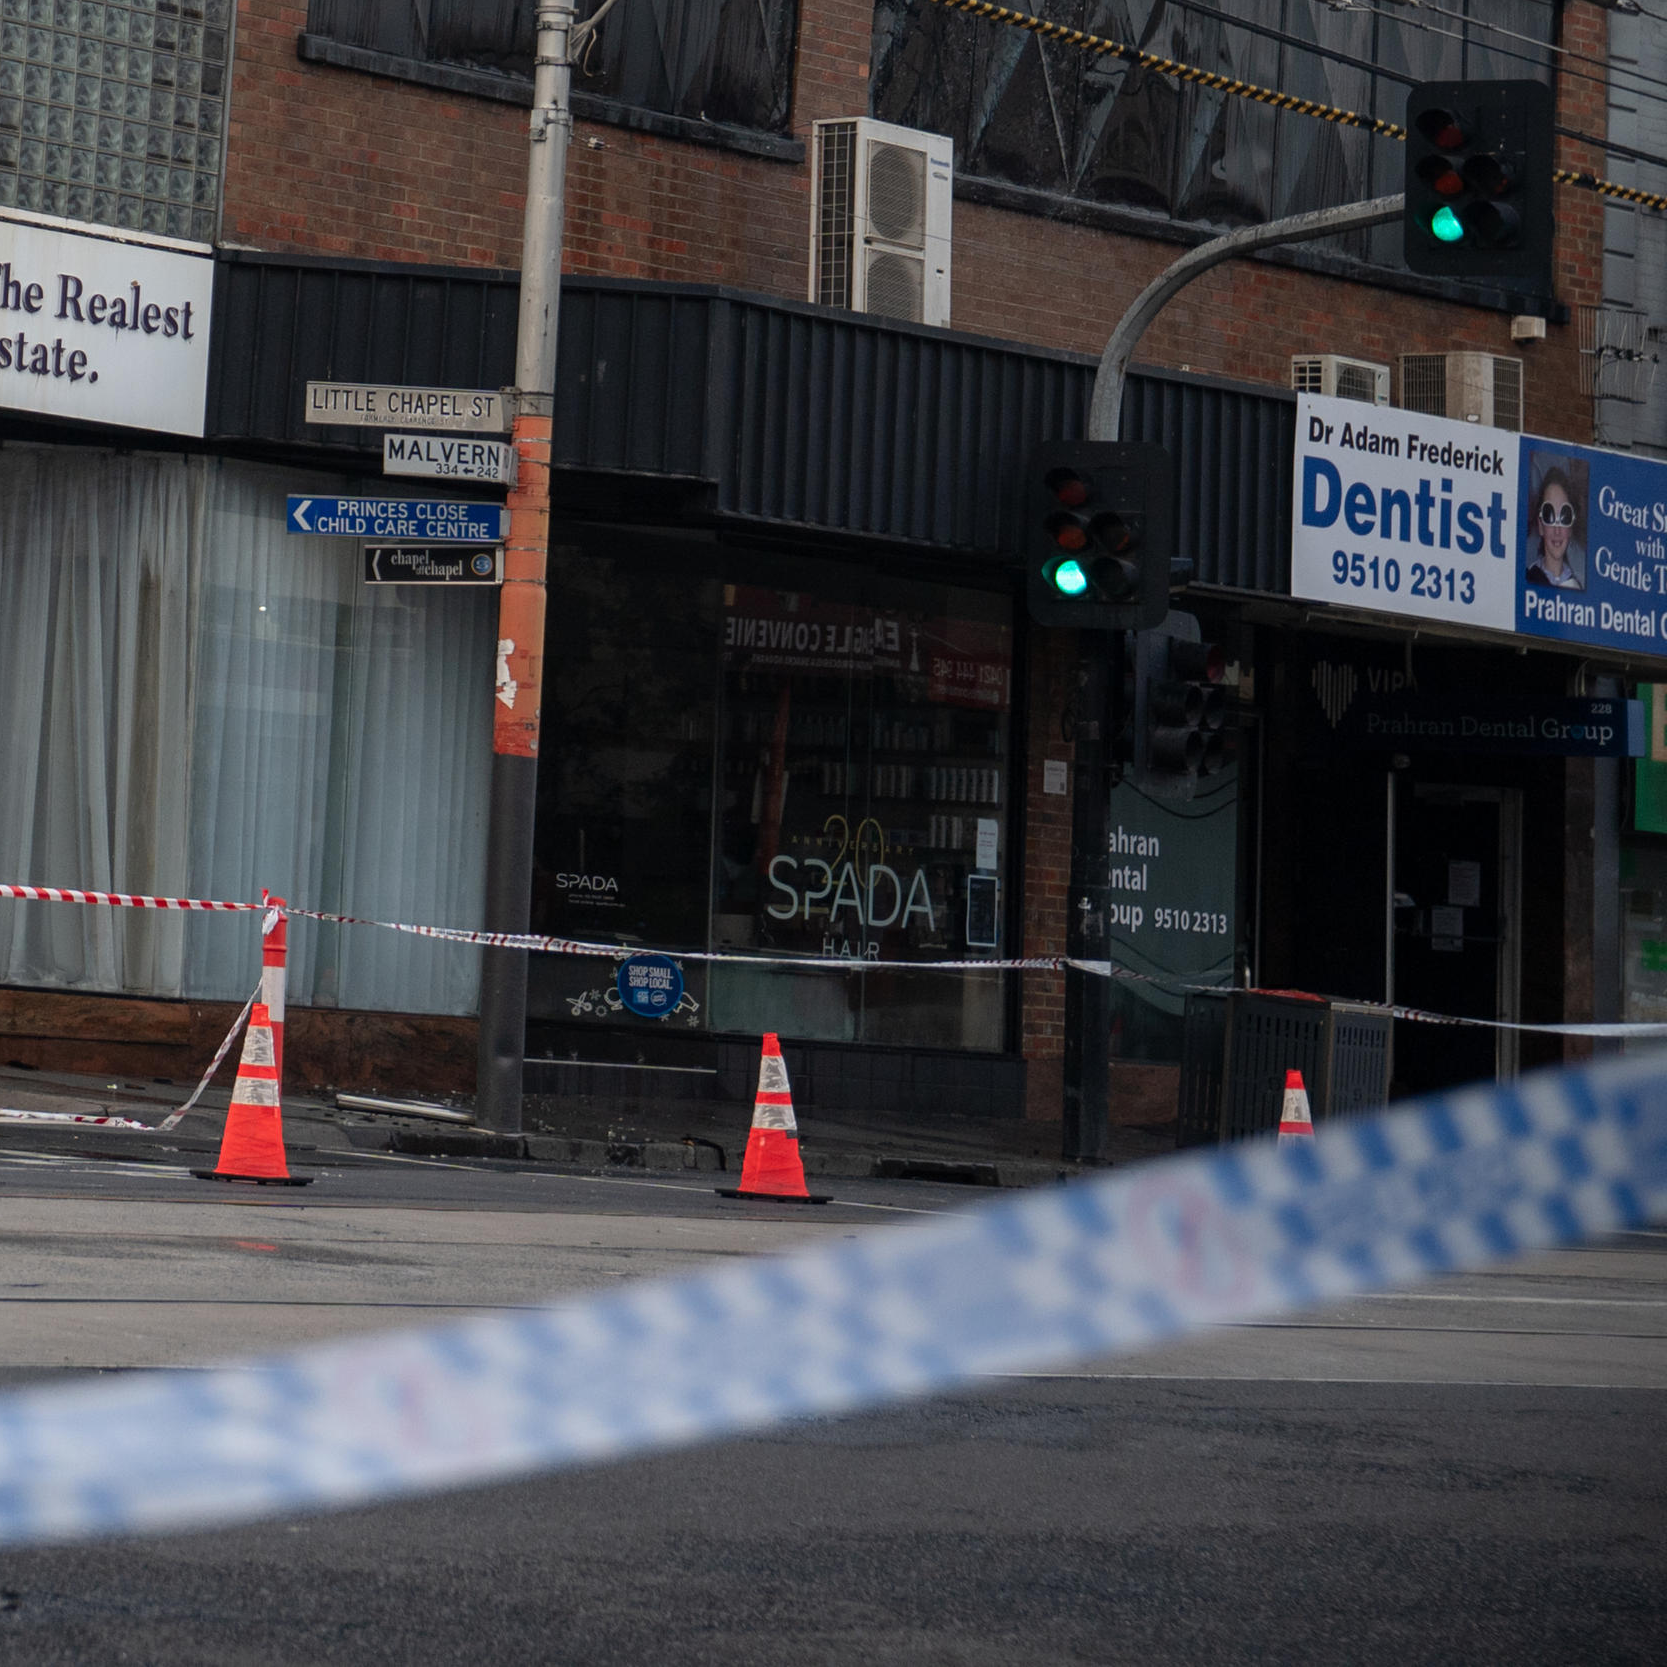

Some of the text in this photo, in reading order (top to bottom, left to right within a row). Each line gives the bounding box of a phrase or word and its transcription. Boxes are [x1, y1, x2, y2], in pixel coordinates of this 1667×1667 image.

[54, 274, 195, 340] Realest
[312, 388, 495, 418] LITTLE CHAPEL ST
[387, 438, 500, 467] MALVERN
[1308, 416, 1505, 476] Dr Adam Frederick
[434, 462, 499, 479] 334 242
[336, 500, 469, 521] PRINCES CLOSE
[1301, 455, 1508, 559] Dentist
[1598, 486, 1667, 534] Great S
[316, 516, 490, 538] CHILD CARE CENTRE
[390, 549, 429, 571] chapel
[1635, 537, 1667, 561] with
[425, 559, 463, 581] chapel
[1331, 550, 1476, 605] 9510 2313
[1595, 546, 1652, 594] Gentle
[1525, 590, 1595, 628] Prahran
[1600, 602, 1656, 636] Dental
[1591, 702, 1612, 715] 228
[1366, 713, 1614, 746] Prahran Dental Group
[1109, 825, 1159, 856] ahran
[555, 873, 619, 892] SPADA
[1108, 863, 1147, 891] ntal
[767, 854, 935, 933] SPADA
[1110, 903, 1227, 935] oup 9510 2313
[822, 937, 881, 960] HAIR
[628, 965, 648, 977] SHOP
[628, 976, 648, 987] SHOP
